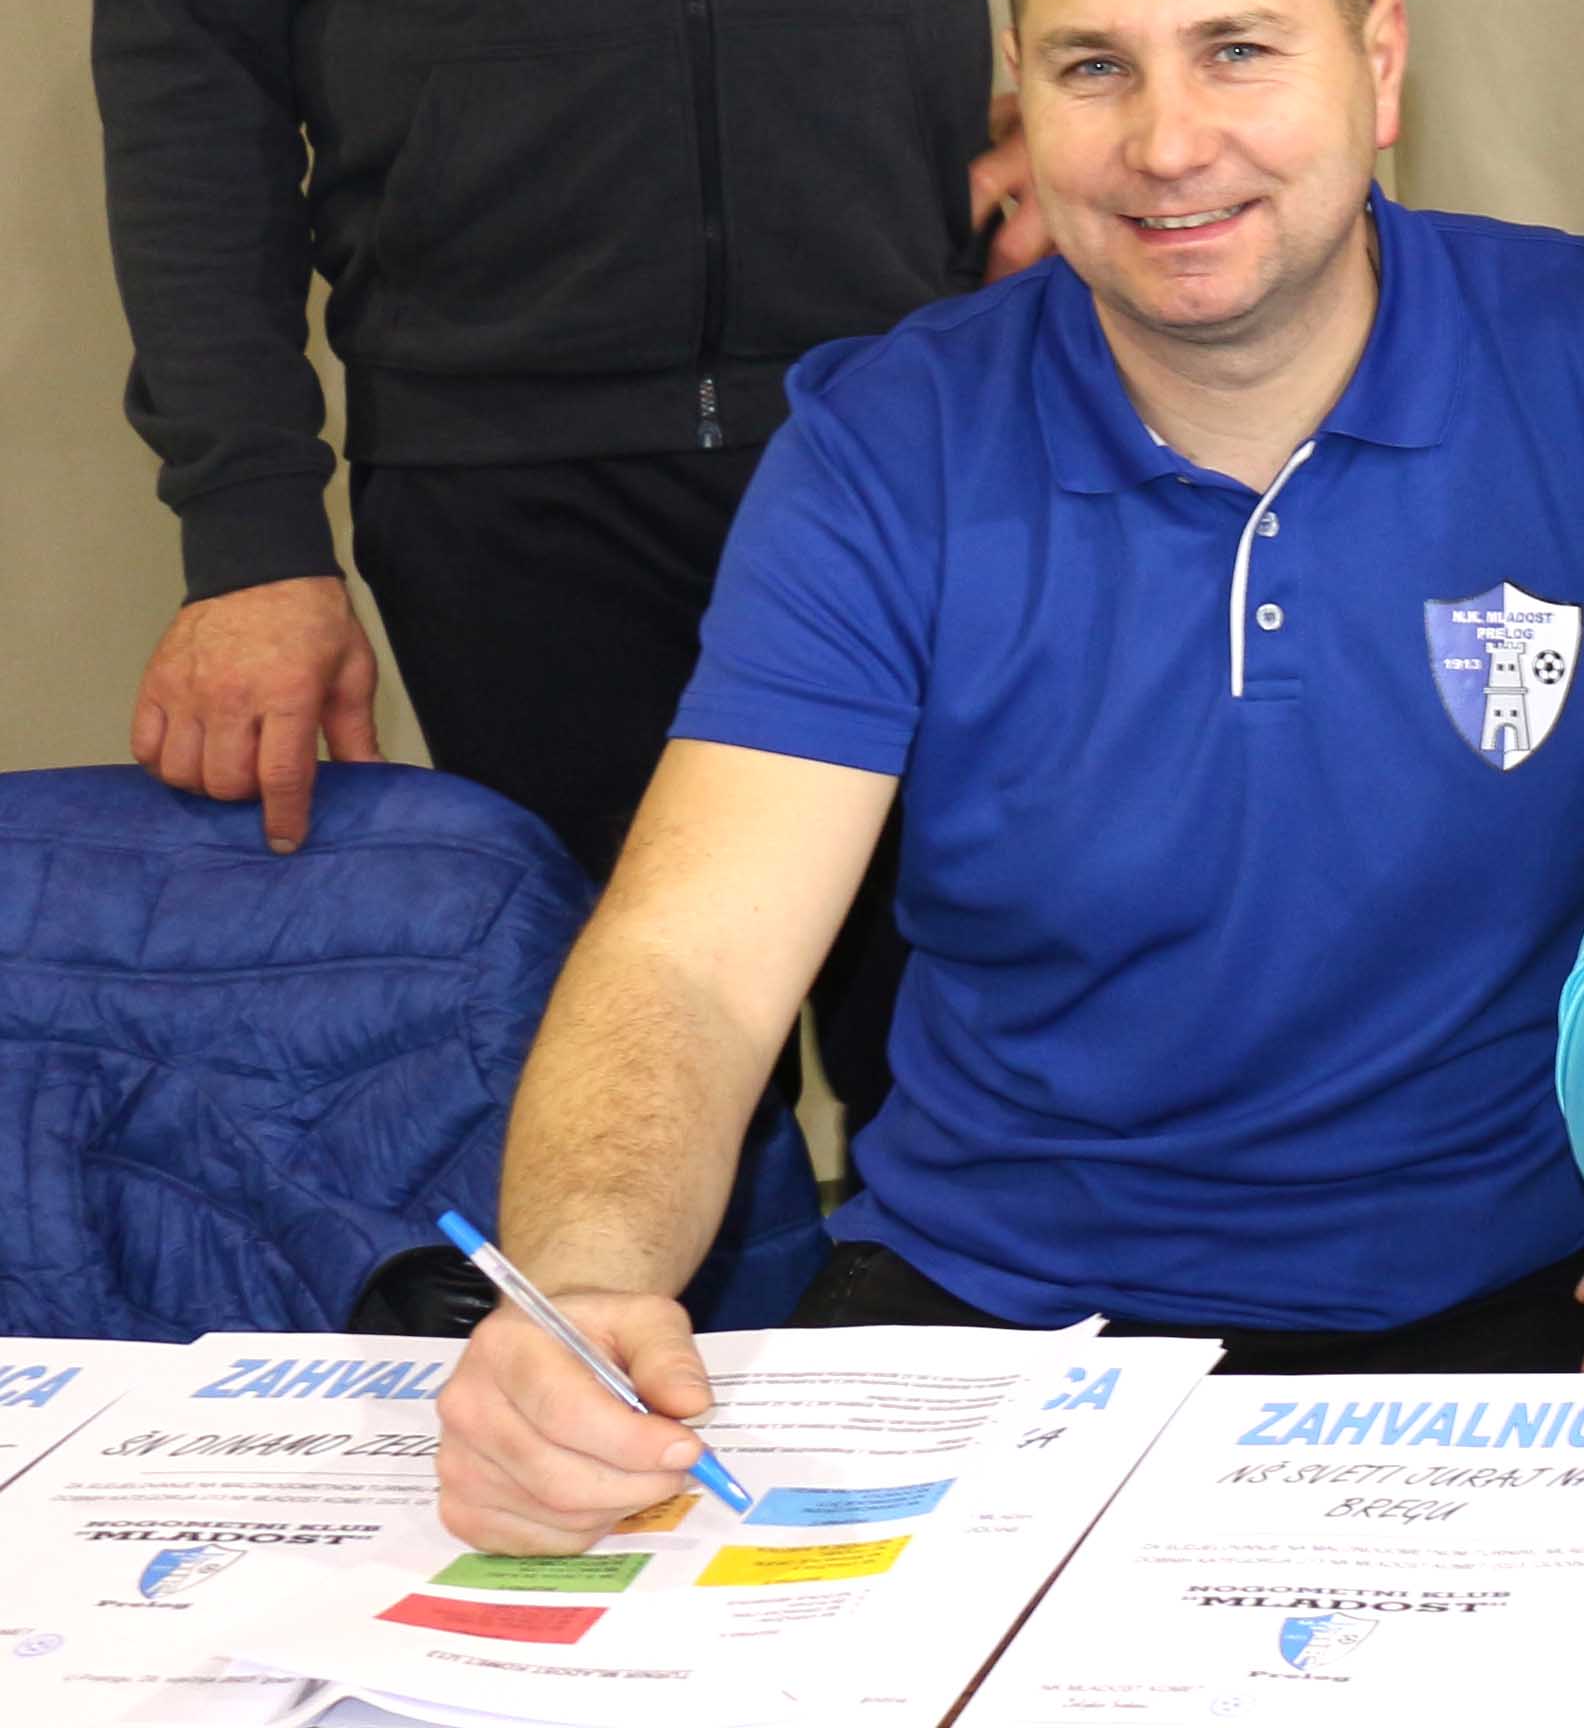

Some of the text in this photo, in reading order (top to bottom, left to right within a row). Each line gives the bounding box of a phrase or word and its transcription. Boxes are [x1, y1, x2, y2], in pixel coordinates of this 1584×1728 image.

[1476, 627, 1535, 640] PRELOG
[1443, 658, 1483, 670] 1913
[191, 1359, 445, 1399] ZAHVAL
[168, 1433, 353, 1457] DINAMO
[1283, 1463, 1405, 1485] SVETI
[1404, 1465, 1553, 1488] JURAJ
[85, 1520, 383, 1533] NOGOMETNI KLUB
[1187, 1585, 1511, 1599] NOGOMETNI KLUB
